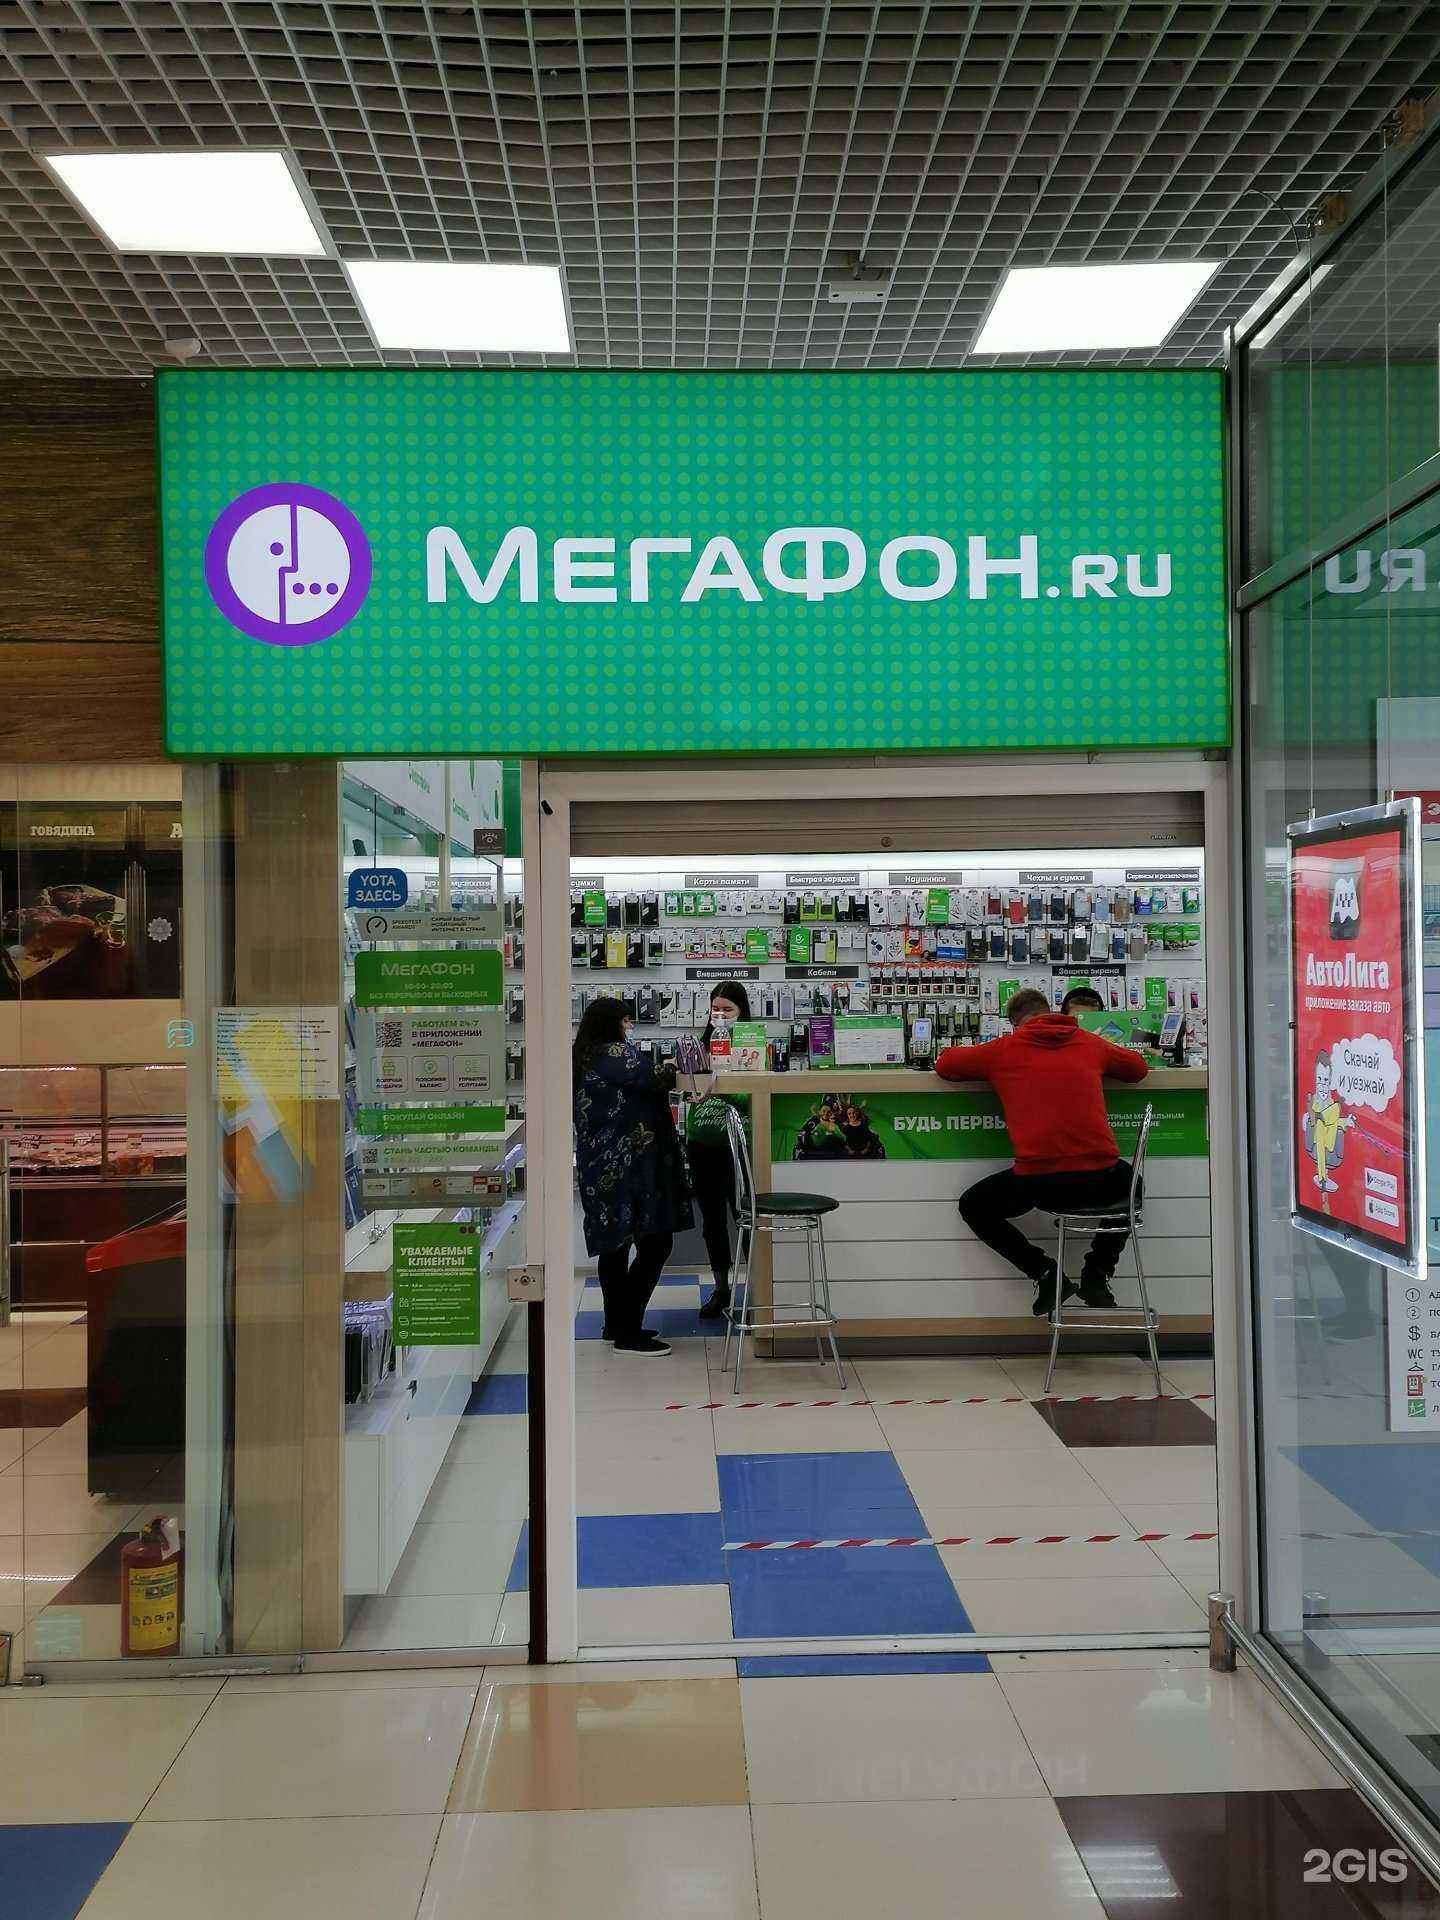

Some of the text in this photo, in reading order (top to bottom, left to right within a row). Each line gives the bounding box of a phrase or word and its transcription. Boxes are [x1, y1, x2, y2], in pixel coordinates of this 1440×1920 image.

[31, 825, 95, 837] ГОВЯДИНА
[360, 875, 396, 887] YOTA
[570, 880, 597, 889] сумки
[693, 878, 718, 887] Карты
[790, 876, 856, 885] Быстрая зарядка
[905, 876, 946, 884] Наушники
[1060, 876, 1086, 884] сумки
[355, 890, 402, 902] ЗДЕСЬ
[732, 970, 749, 978] АКБ
[807, 969, 837, 977] Кабели
[1058, 968, 1120, 976] Защита экрана
[1305, 953, 1390, 990] АвтоЛига
[1305, 997, 1391, 1014] приложение заказа авто
[411, 1020, 457, 1028] РАБОТАЕМ
[419, 1029, 482, 1038] ПРИЛОЖЕНИИ
[1343, 1049, 1380, 1070] Скачай
[1339, 1078, 1385, 1096] и уезжай
[893, 1116, 942, 1132] БУДЬ
[453, 1145, 499, 1153] КОМАНДЫ
[400, 1246, 473, 1256] УВАЖАЕМЫЕ
[1407, 1348, 1424, 1359] WC
